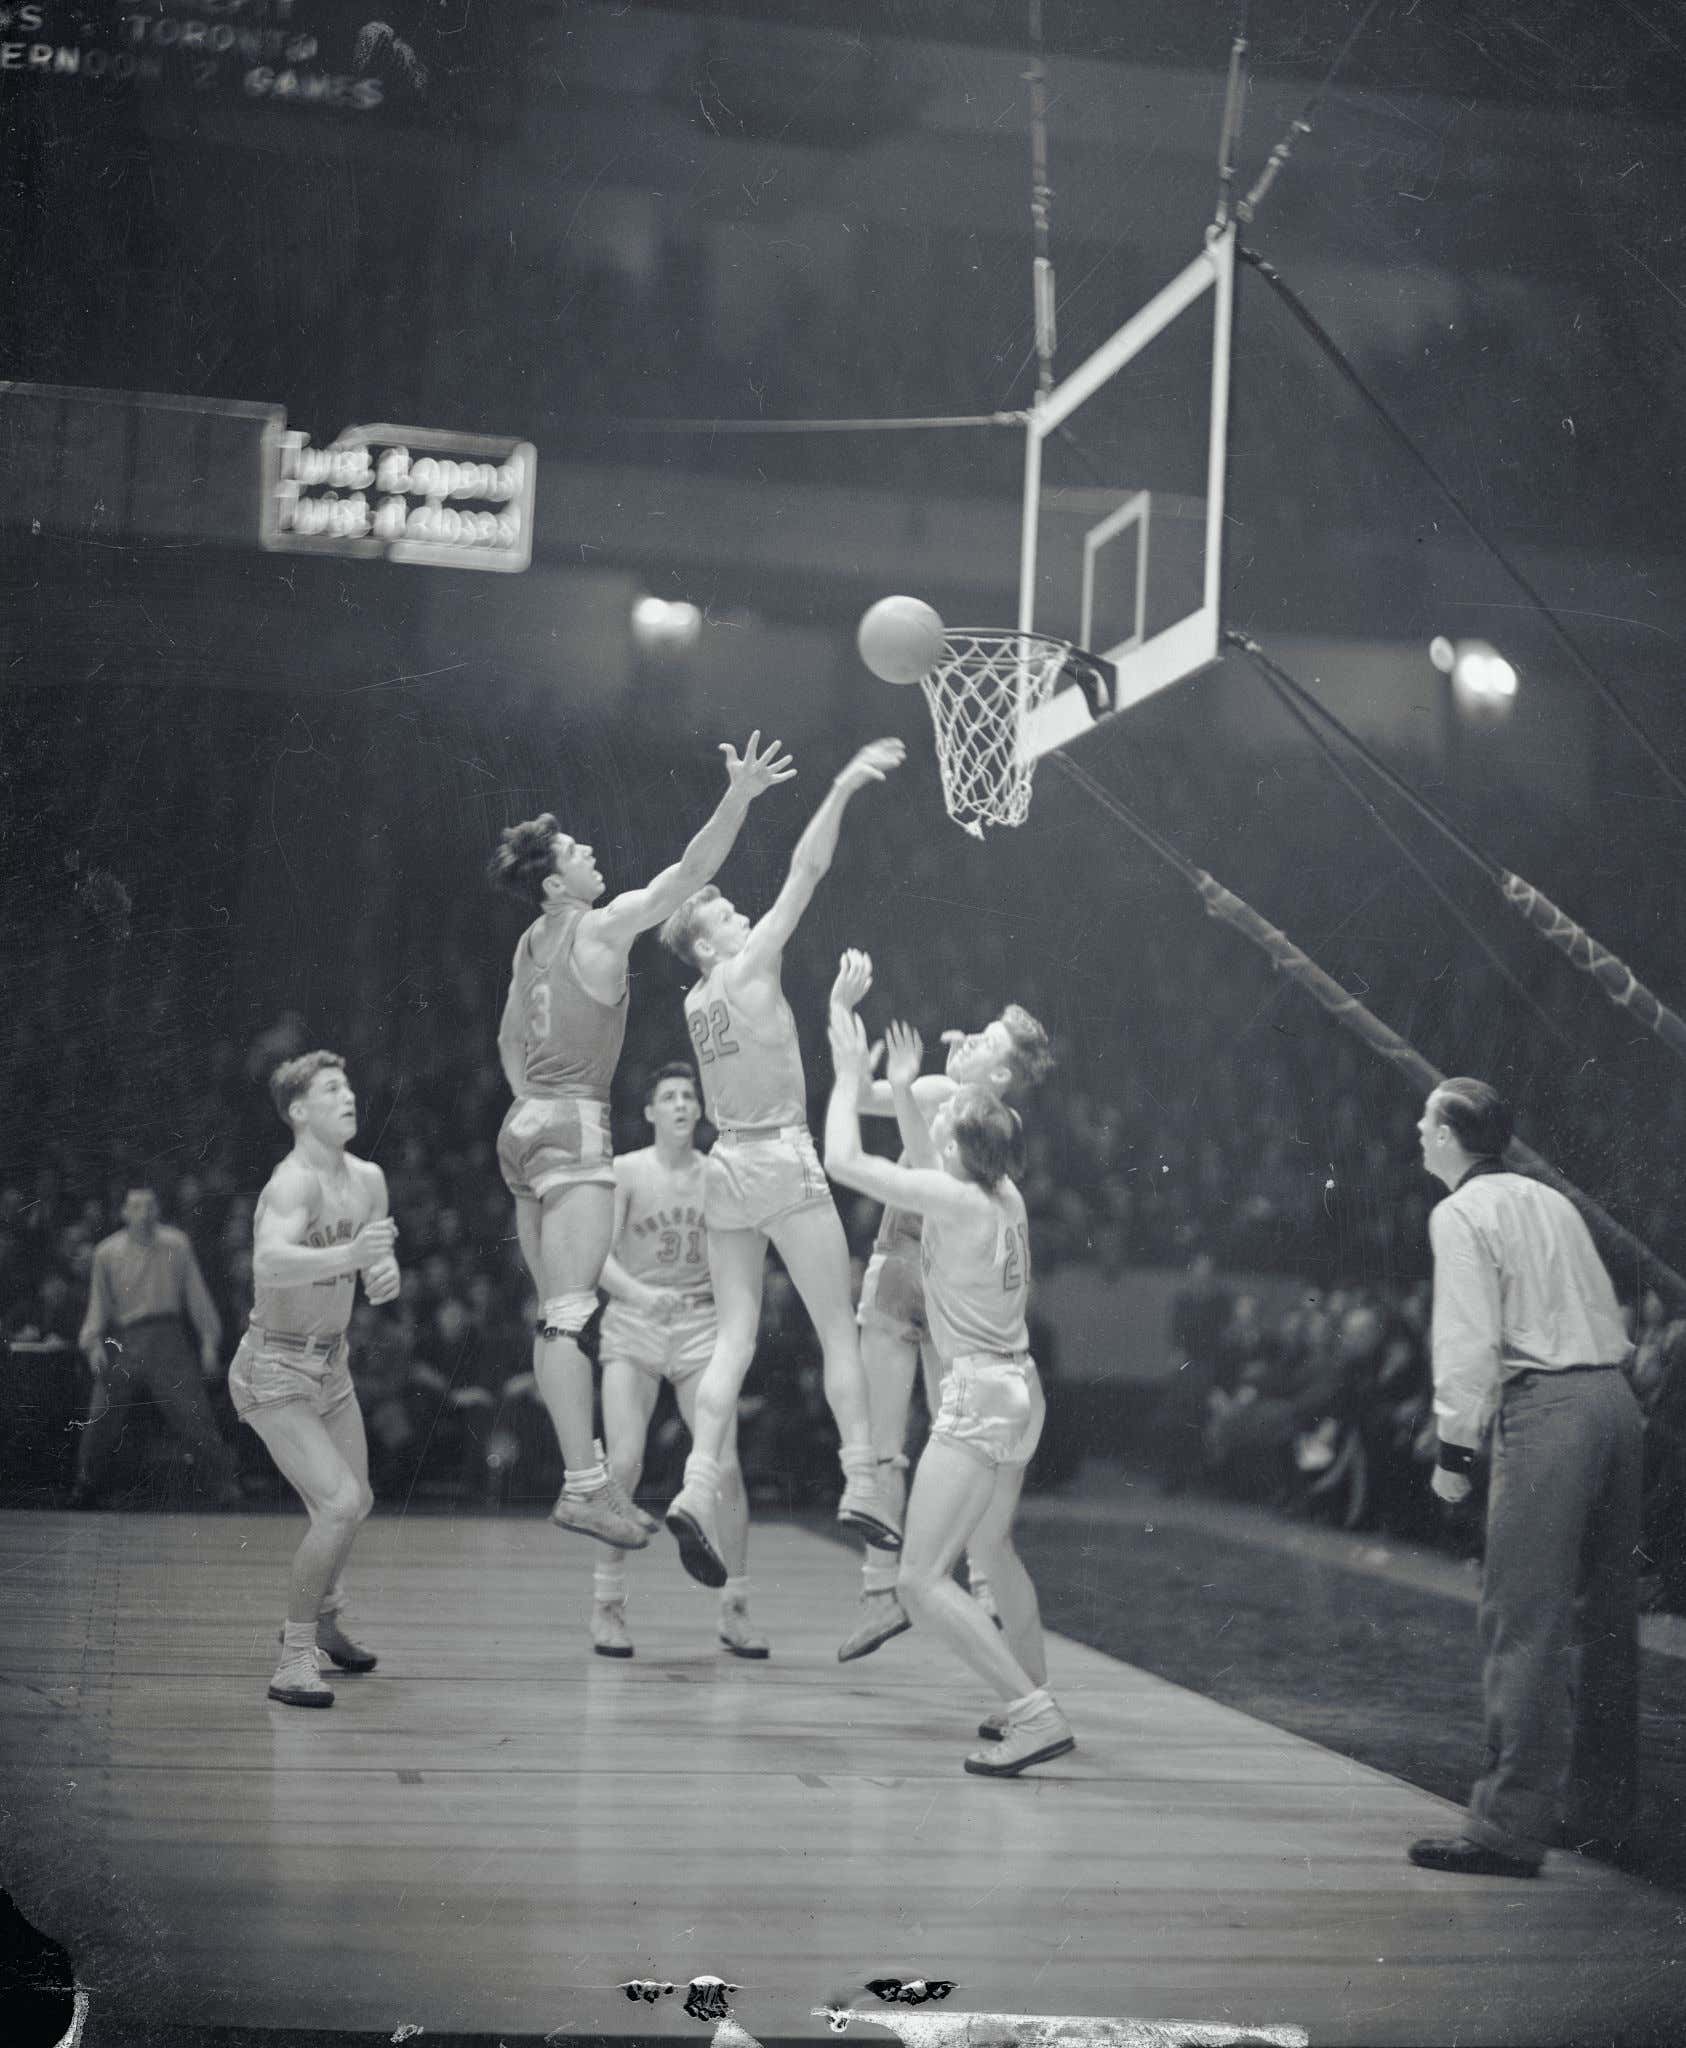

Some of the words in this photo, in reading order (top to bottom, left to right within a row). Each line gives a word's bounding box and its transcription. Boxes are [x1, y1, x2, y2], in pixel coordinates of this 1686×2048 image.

[531, 983, 552, 1038] 3
[688, 999, 740, 1065] 22
[655, 1230, 701, 1265] 31
